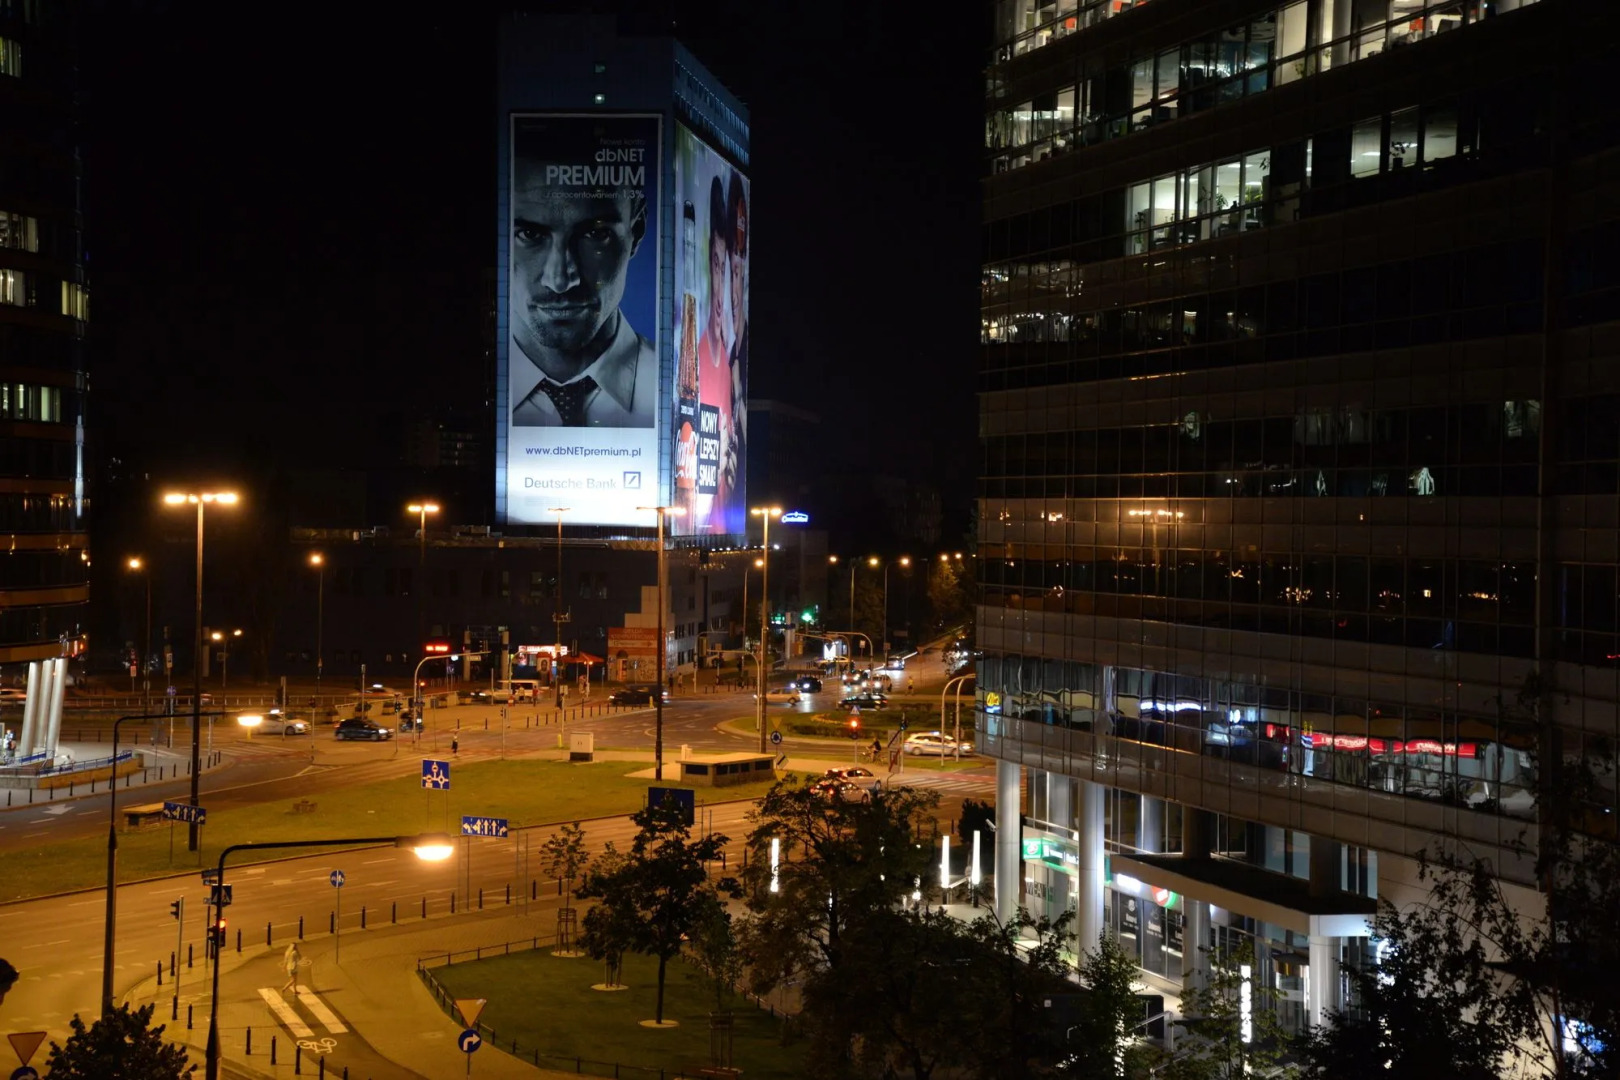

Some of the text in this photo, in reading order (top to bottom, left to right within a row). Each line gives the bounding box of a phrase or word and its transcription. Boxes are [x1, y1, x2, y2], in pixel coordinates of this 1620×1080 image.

[594, 148, 645, 163] dbNET
[545, 165, 645, 186] PREMIUM
[700, 410, 718, 434] NOWY
[525, 446, 641, 457] www.dbNETpremium.pl
[699, 437, 719, 461] LEPSZY
[524, 477, 616, 489] Deutsche Bank
[699, 464, 716, 487] SMAK!
